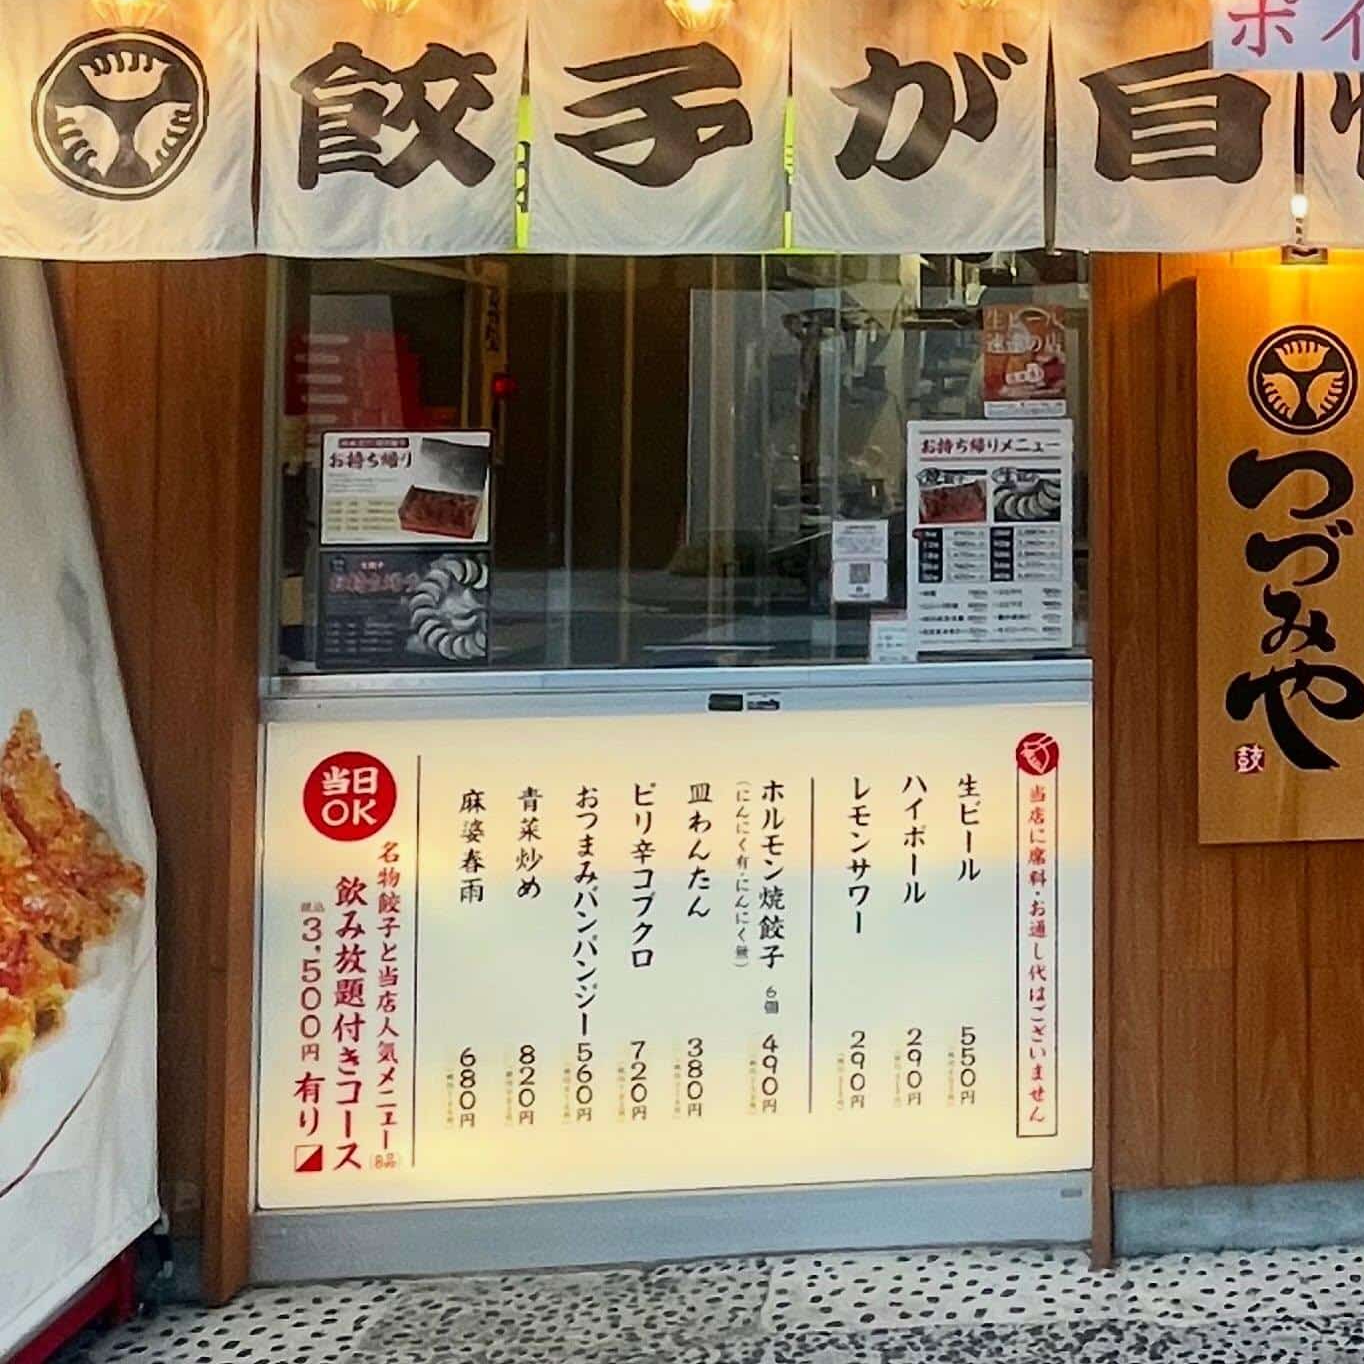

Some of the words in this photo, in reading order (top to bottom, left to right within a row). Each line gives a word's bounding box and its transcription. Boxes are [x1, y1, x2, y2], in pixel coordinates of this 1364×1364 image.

[321, 765, 379, 796] 当日
[321, 798, 377, 826] OK
[459, 788, 486, 904] 麻婆春雨
[516, 786, 543, 899] 青菜炒め
[688, 782, 712, 918] 皿わんたん
[848, 776, 871, 934] レモンサワー
[902, 775, 927, 904] ハイボール
[958, 773, 981, 882] 生ビール
[759, 780, 785, 969] ホルモン焼餃子
[332, 876, 368, 1171] 飲み放題付きコース
[459, 1046, 476, 1128] 680円
[518, 1044, 535, 1125] 820円
[576, 1042, 593, 1122] 560円
[630, 1040, 648, 1121] 720円
[687, 1037, 704, 1117] 380円
[761, 1034, 779, 1114] 490円
[849, 1030, 866, 1109] 290円
[906, 1027, 922, 1106] 290円
[960, 1025, 976, 1105] 550円
